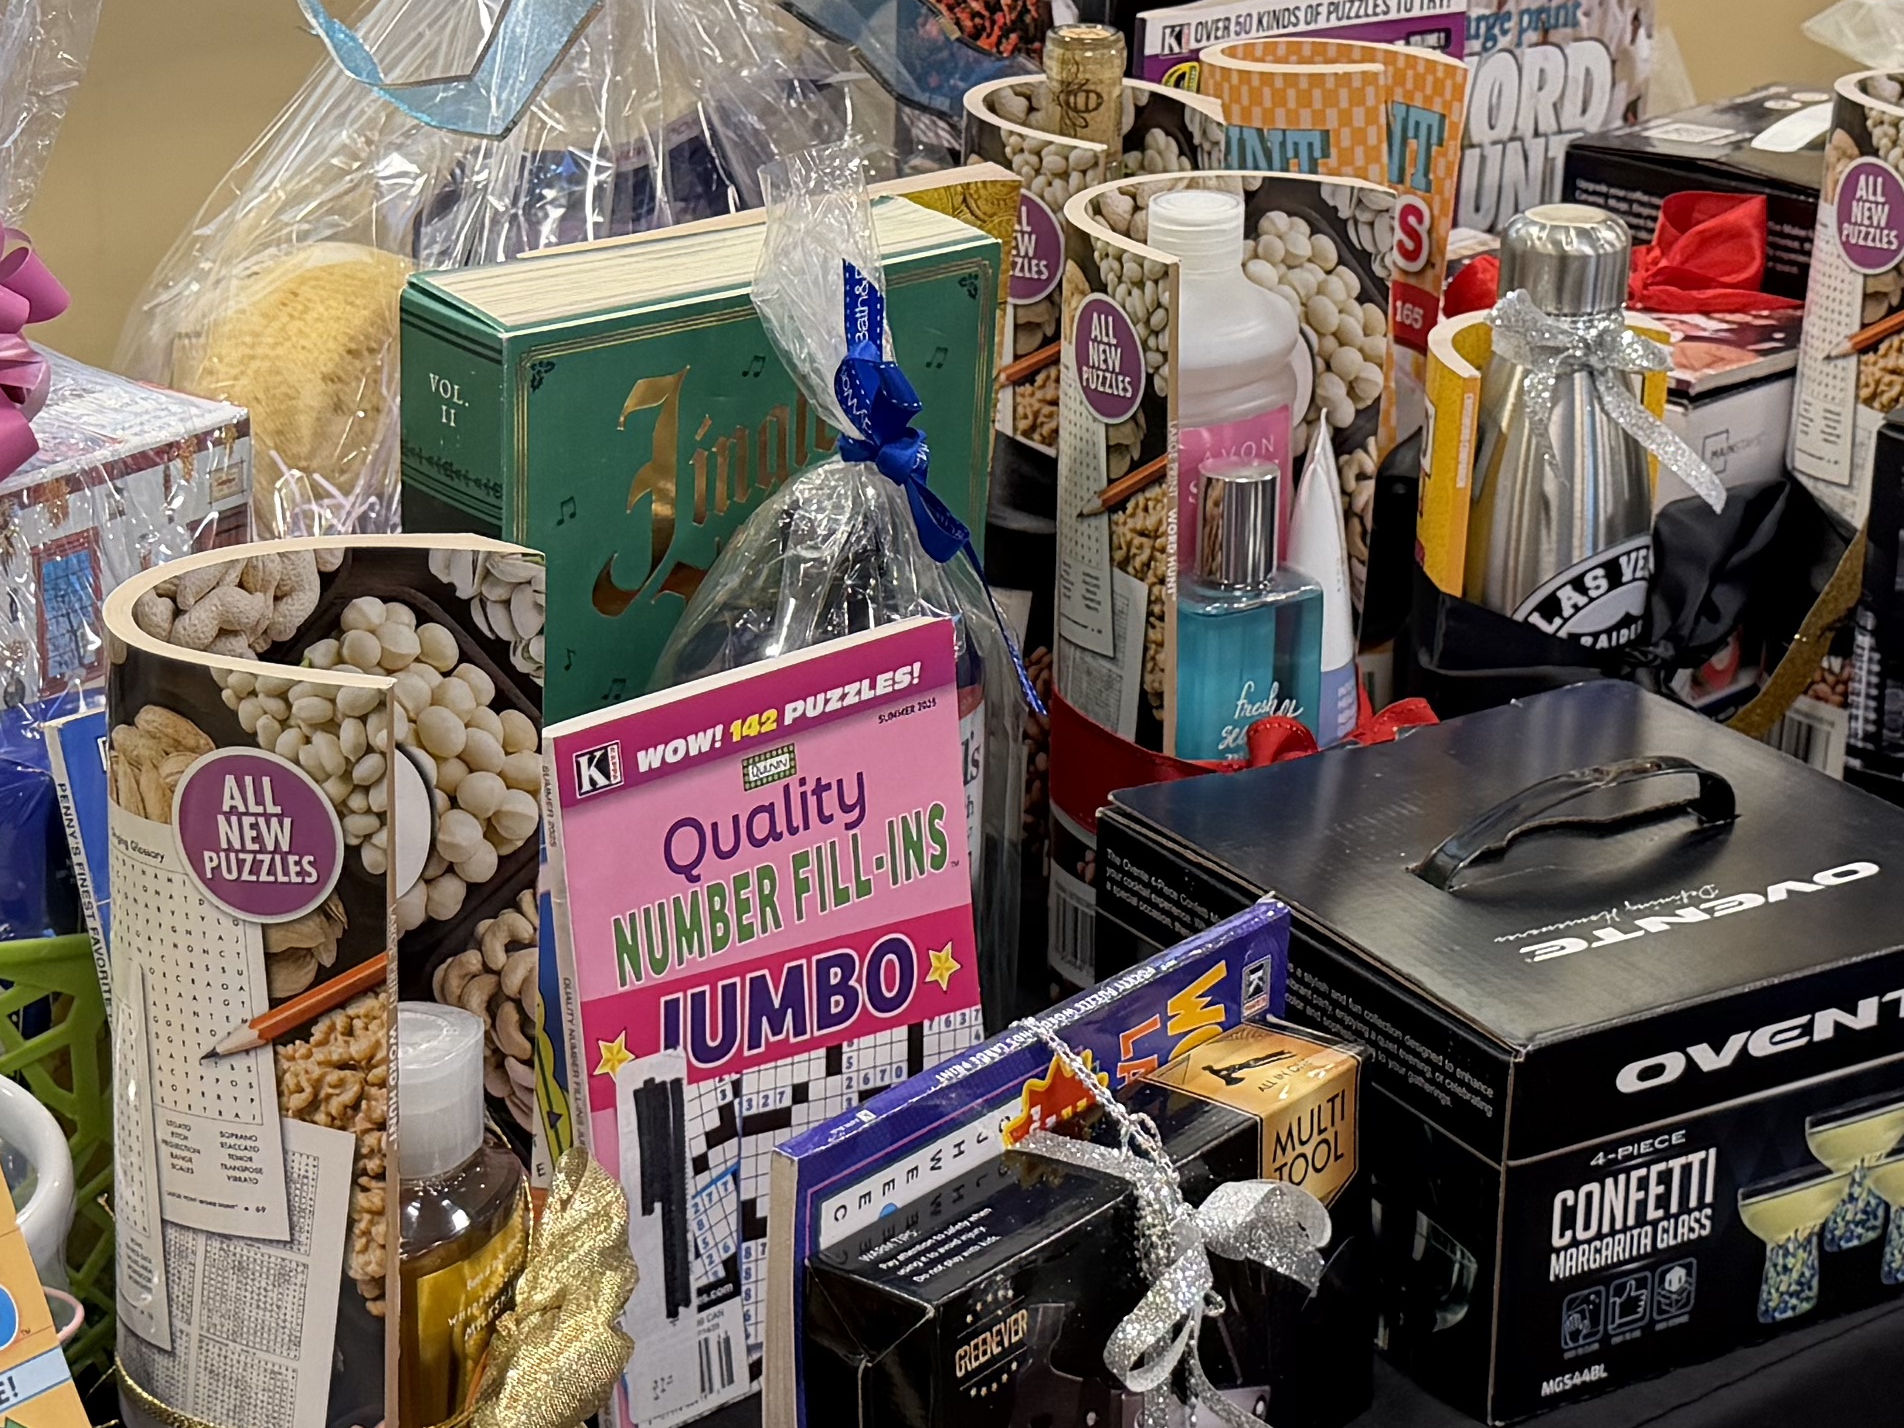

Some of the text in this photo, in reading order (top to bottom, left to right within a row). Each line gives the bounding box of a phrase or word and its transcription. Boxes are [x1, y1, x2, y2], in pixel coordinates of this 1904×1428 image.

[1195, 14, 1231, 43] OVER
[1234, 11, 1253, 36] 50
[1257, 5, 1300, 35] KINDS
[1303, 2, 1323, 26] OF
[1467, 38, 1613, 143] ORD
[1461, 130, 1583, 232] UNT
[1855, 174, 1885, 203] ALL
[1842, 223, 1899, 251] PUZZLES
[1851, 200, 1889, 228] NEW
[1091, 311, 1117, 345] ALL
[1395, 300, 1425, 330] 165
[1089, 340, 1122, 370] NEW
[428, 373, 470, 409] VOL.
[1082, 368, 1132, 400] PUZZLES
[440, 404, 457, 429] II
[1166, 508, 1177, 595] WORD HUNT
[1527, 567, 1609, 635] LAS
[637, 661, 922, 773] WOW! 142 PUZZLES!
[222, 774, 282, 814] ALL
[57, 782, 82, 857] PENNY'S
[76, 860, 96, 922] FINEST
[217, 814, 293, 853] NEW
[663, 770, 866, 883] Quality
[203, 850, 319, 884] PUZZLES
[612, 801, 949, 991] NUMBER FILL-INS
[1519, 861, 1880, 963] OVENTE
[660, 932, 917, 1069] JUMBO
[1272, 1089, 1346, 1165] MULTI
[1589, 1130, 1687, 1167] 4-PIECE
[1273, 1130, 1345, 1186] TOOL
[1551, 1147, 1717, 1248] CONFETTI
[1549, 1207, 1712, 1283] MARGARITA GLASS
[954, 1308, 1028, 1378] GREENEVER
